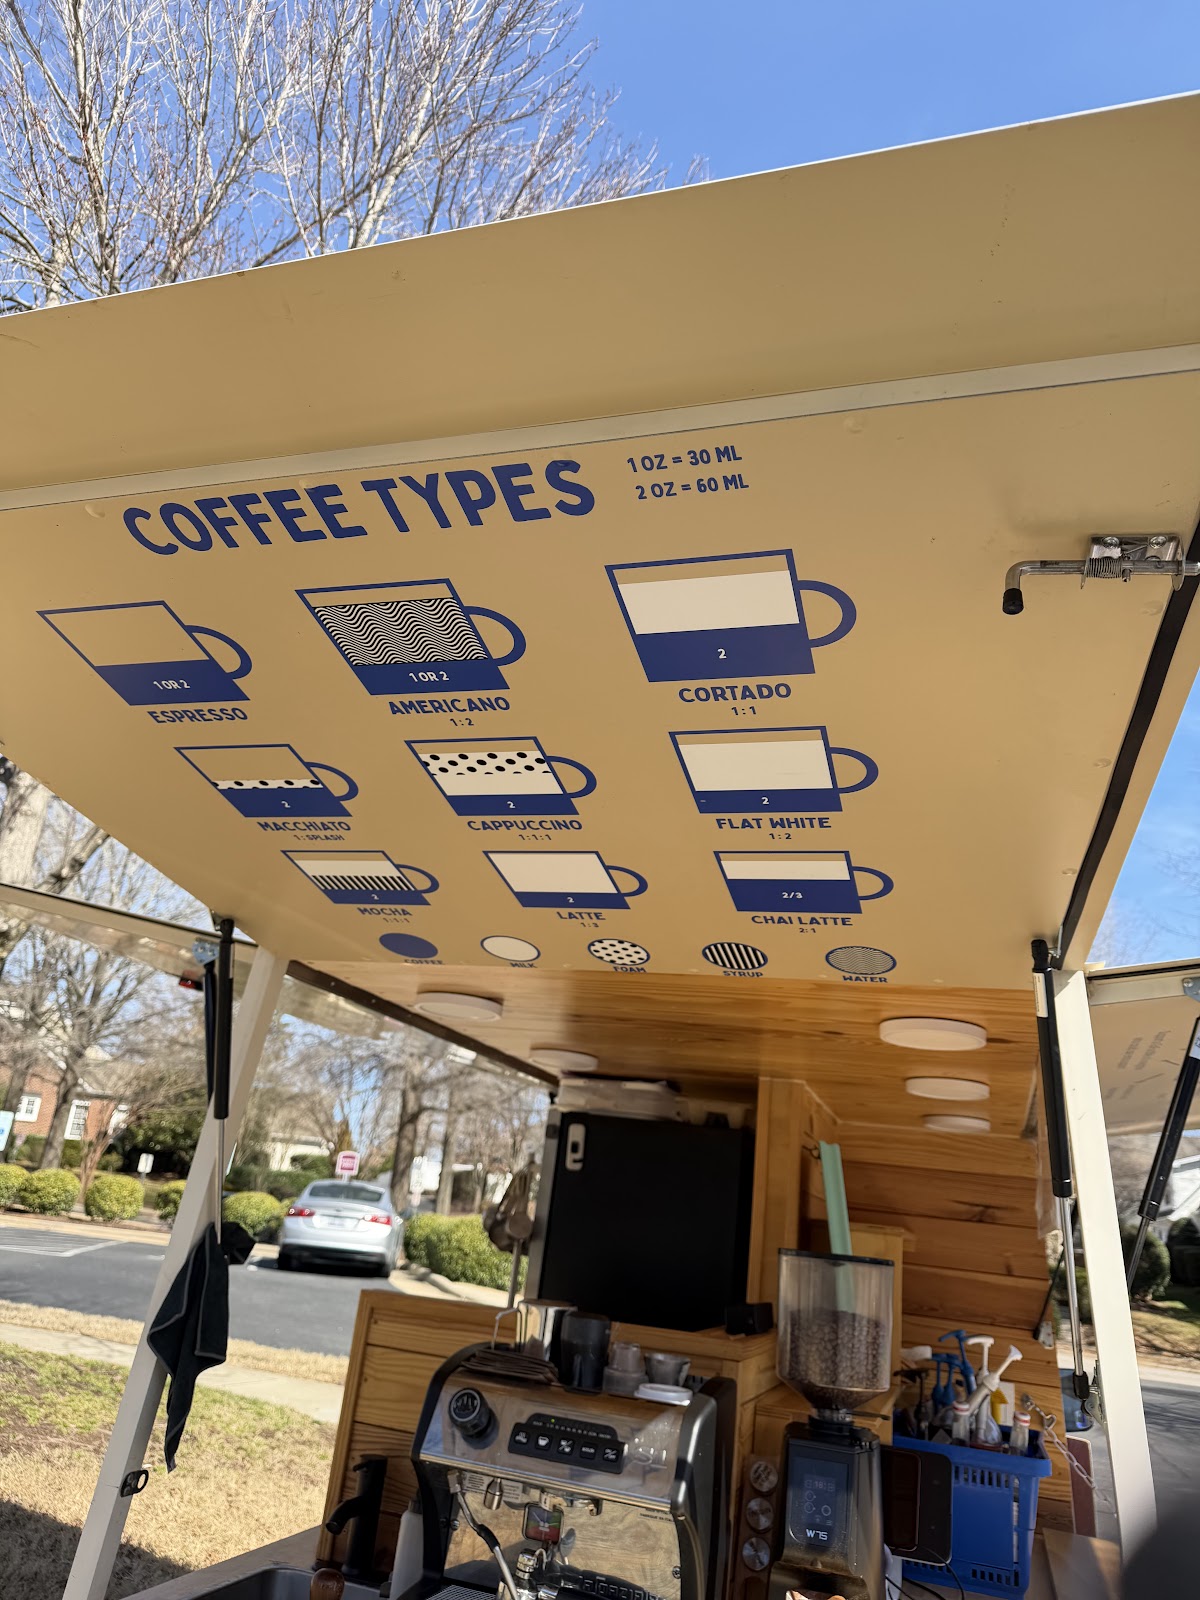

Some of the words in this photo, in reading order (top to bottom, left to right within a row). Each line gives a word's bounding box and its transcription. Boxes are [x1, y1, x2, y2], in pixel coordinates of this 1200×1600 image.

[626, 457, 638, 473] 1
[640, 453, 669, 472] OZ
[686, 448, 711, 466] 30
[714, 445, 743, 463] ML
[635, 485, 648, 500] 2
[650, 481, 678, 498] OZ
[696, 477, 719, 493] 60
[722, 473, 750, 491] ML
[122, 483, 368, 556] COFFEE
[360, 458, 596, 534] TYPES
[717, 648, 727, 659] 2
[408, 672, 418, 682] 1
[418, 671, 438, 682] OR
[439, 671, 450, 681] 2
[153, 680, 163, 690] 1
[162, 680, 181, 690] OR
[180, 679, 191, 689] 2
[678, 682, 792, 703] CORTADO
[389, 695, 511, 716] AMERICANO
[148, 707, 249, 724] ESPRESSO
[506, 801, 516, 809] 2
[761, 796, 770, 805] 2
[256, 821, 351, 832] MACCHIATO
[467, 819, 583, 831] CAPPUCCINO
[715, 817, 764, 830] FLAT
[768, 816, 832, 829] WHITE
[781, 891, 804, 899] 2/3
[356, 906, 413, 917] MOCHA
[556, 911, 607, 921] LATTE
[751, 915, 794, 925] CHAI
[797, 916, 854, 926] LATTE
[723, 970, 764, 978] SYRUP
[842, 975, 889, 984] WATER
